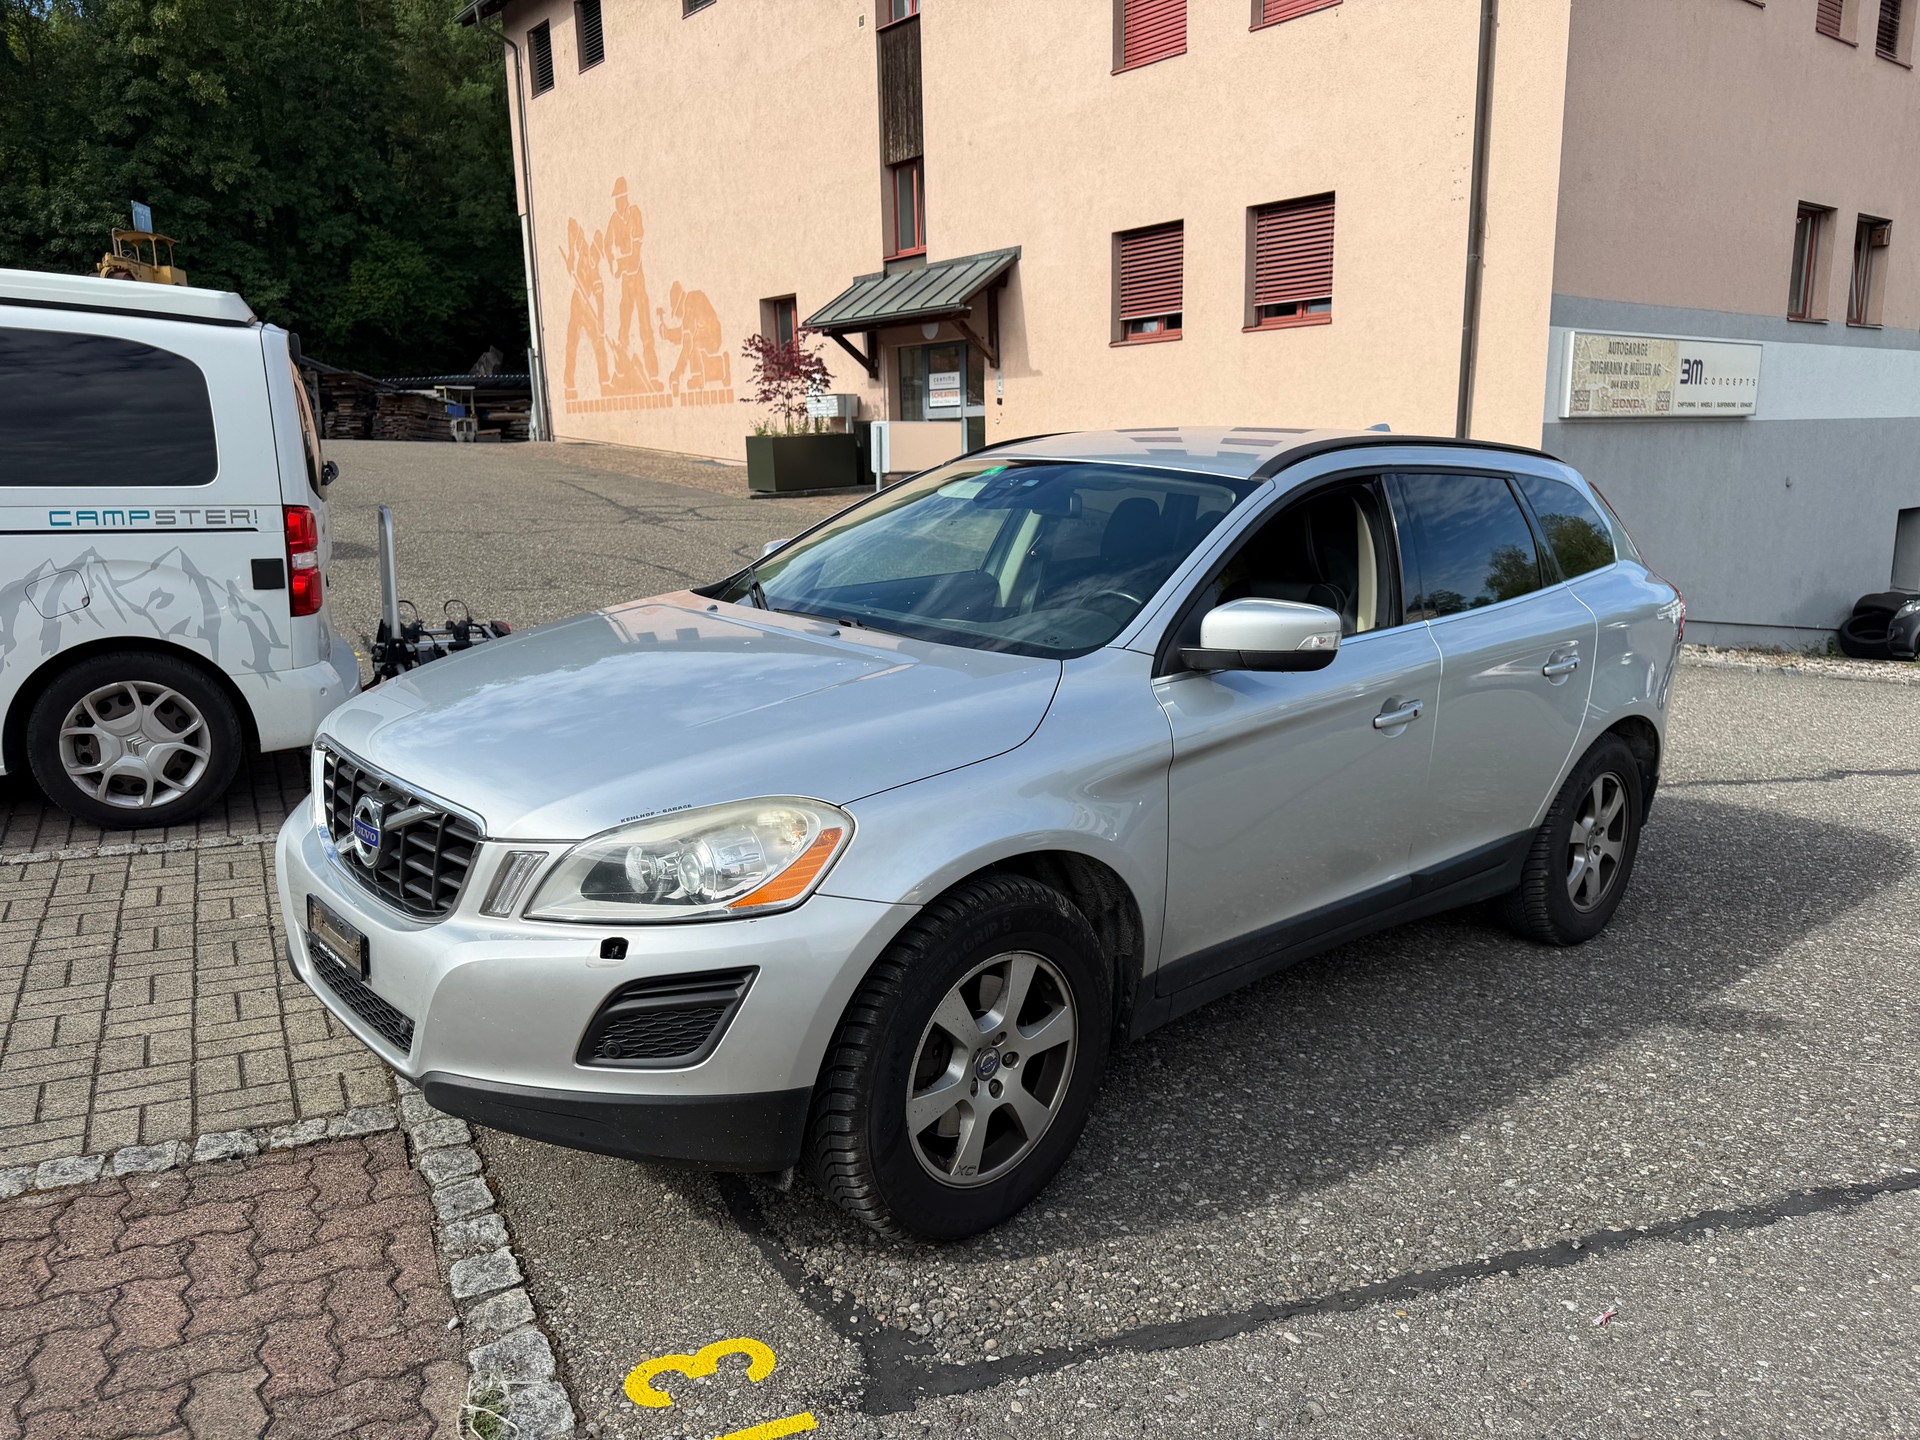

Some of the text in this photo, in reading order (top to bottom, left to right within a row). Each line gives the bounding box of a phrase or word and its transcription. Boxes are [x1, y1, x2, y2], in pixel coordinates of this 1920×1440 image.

[1608, 341, 1648, 357] AUTOGARAGE
[1590, 359, 1662, 377] BUGMANN & MÜLLER AG
[1611, 398, 1647, 409] HONDA
[49, 509, 258, 527] CAMPSTER!
[662, 804, 692, 814] GARAGE
[953, 1164, 977, 1177] XC
